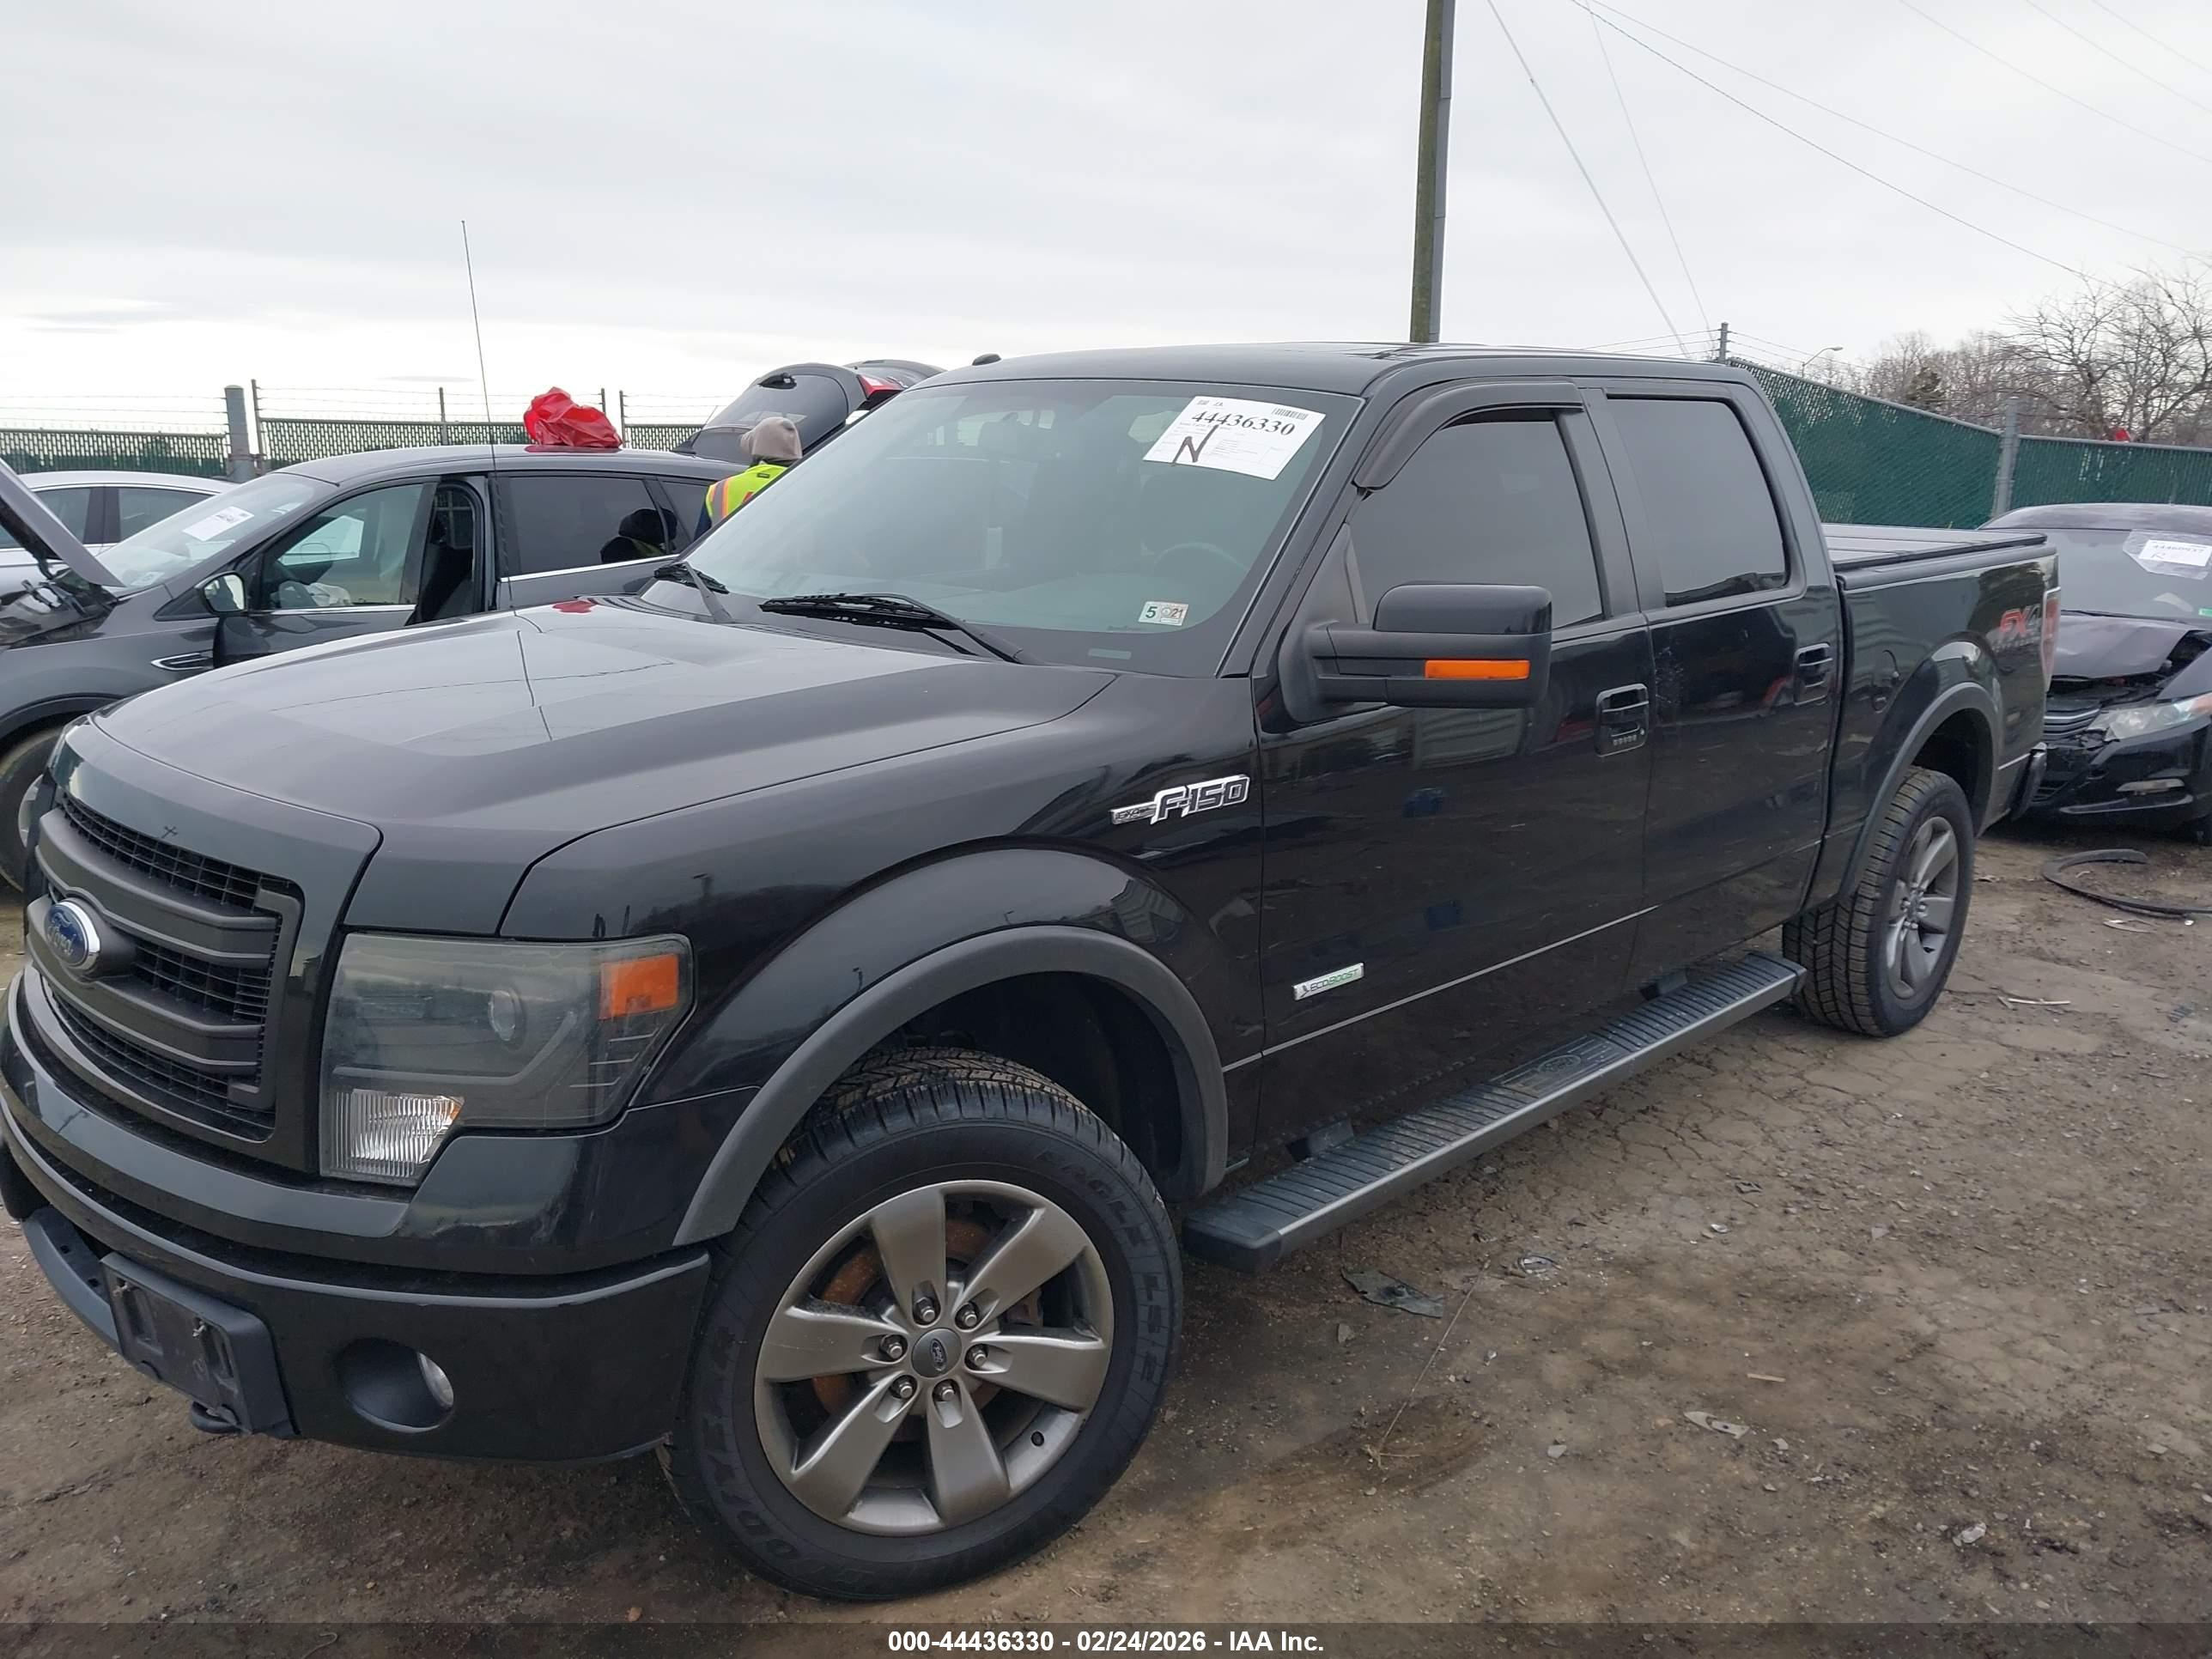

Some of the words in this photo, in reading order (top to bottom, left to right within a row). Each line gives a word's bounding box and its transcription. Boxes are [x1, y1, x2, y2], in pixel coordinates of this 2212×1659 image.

[1191, 410, 1296, 435] 44436330
[1171, 424, 1219, 466] N
[1146, 606, 1158, 618] 5
[1170, 608, 1183, 619] 21
[1150, 774, 1250, 824] F-150
